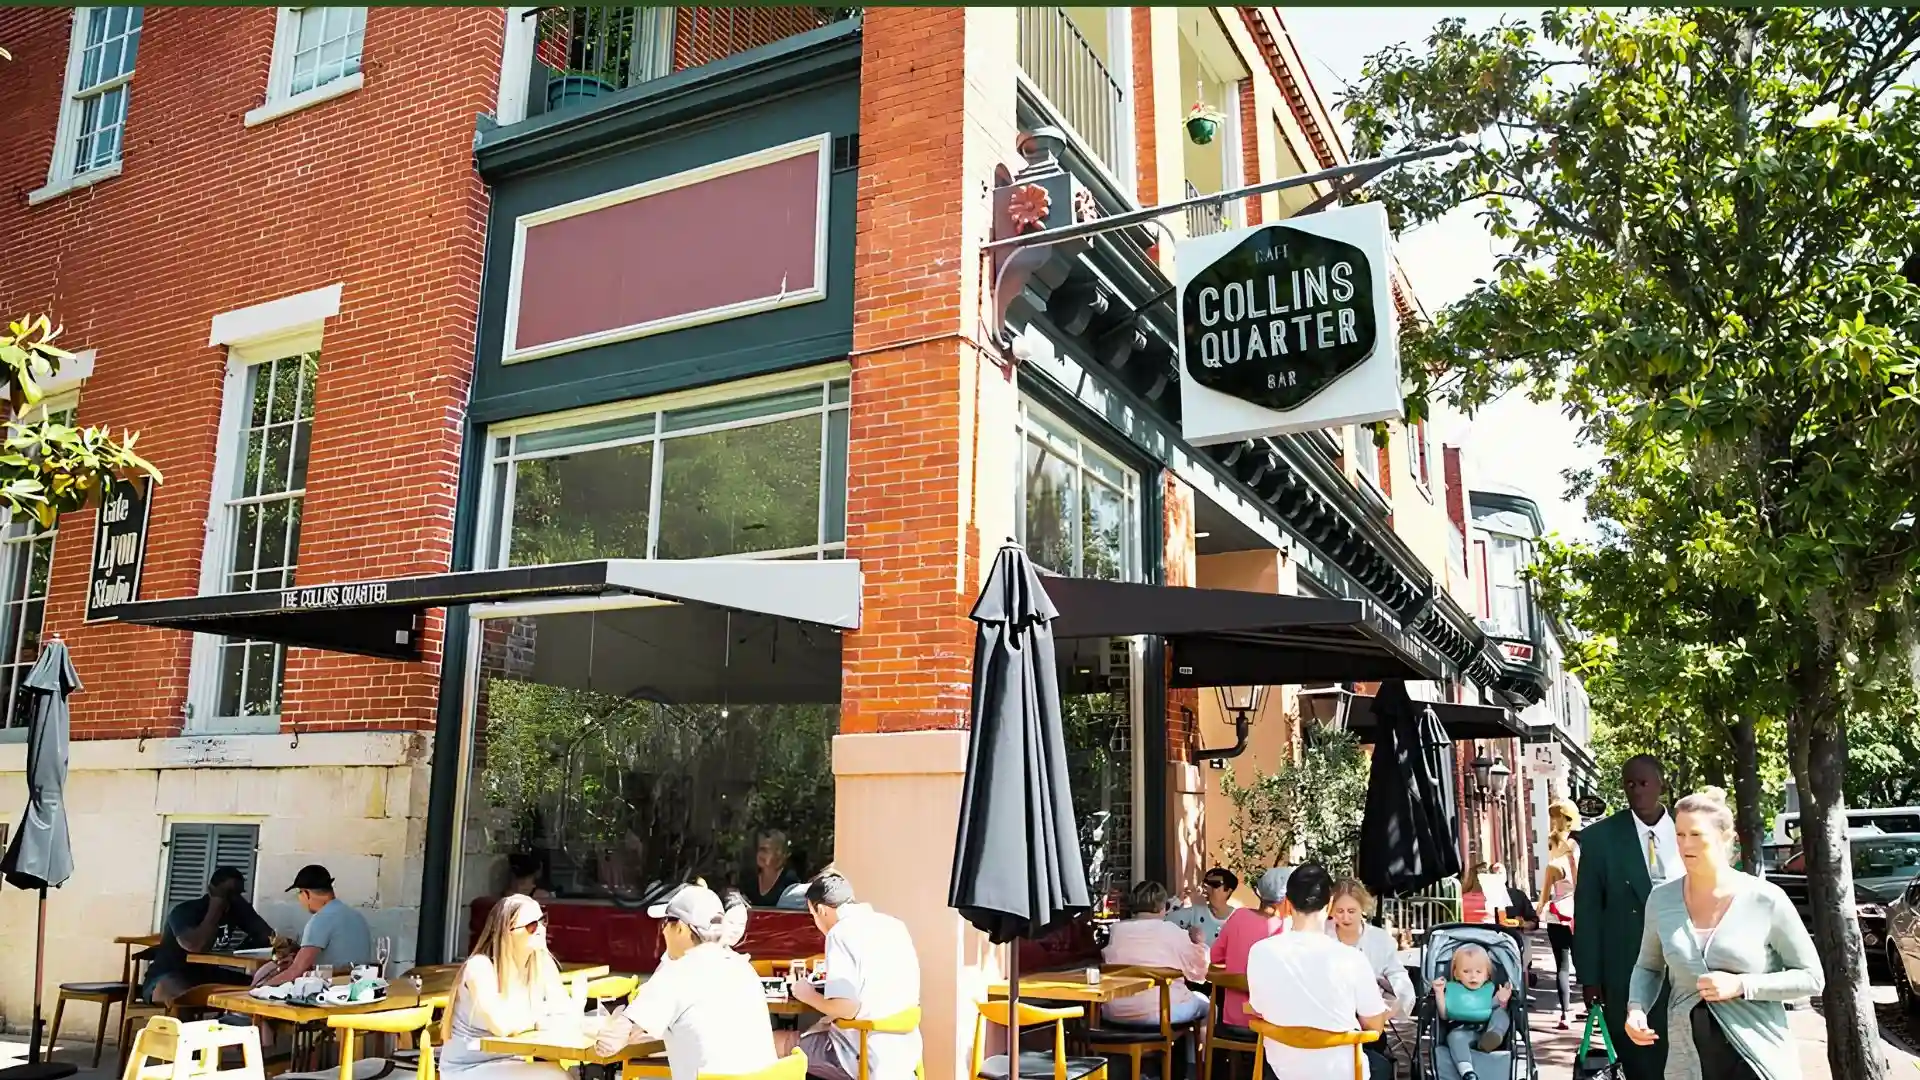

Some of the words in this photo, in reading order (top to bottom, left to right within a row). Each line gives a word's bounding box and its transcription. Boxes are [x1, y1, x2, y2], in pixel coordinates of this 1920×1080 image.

[1198, 261, 1355, 327] COLLINS
[1200, 308, 1358, 368] QUARTER
[1267, 370, 1297, 389] BAR
[98, 526, 138, 577] Lyon
[280, 590, 298, 609] THE
[300, 587, 340, 609] COLLINS
